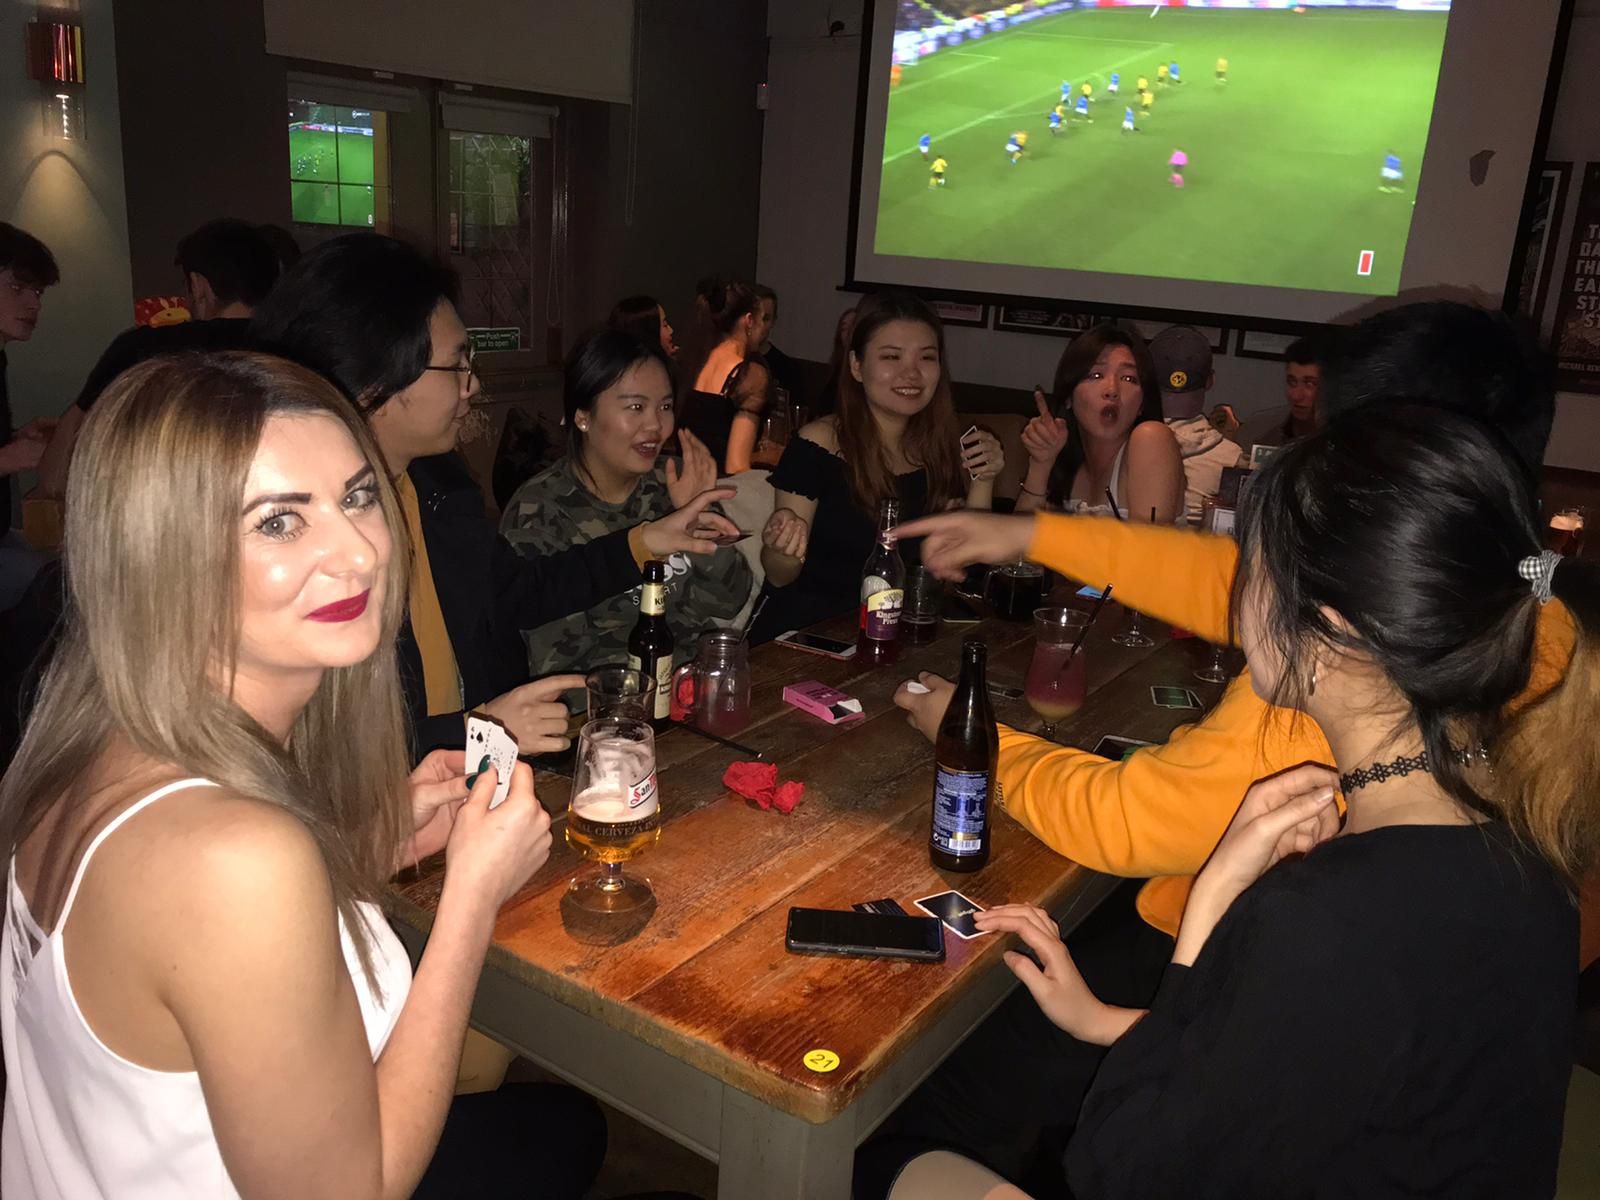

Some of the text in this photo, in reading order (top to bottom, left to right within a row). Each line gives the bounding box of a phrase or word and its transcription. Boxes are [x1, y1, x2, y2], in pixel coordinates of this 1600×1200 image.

[1588, 224, 1600, 240] T
[1574, 277, 1600, 293] EA
[1576, 295, 1600, 311] ST
[809, 1054, 834, 1069] 21
